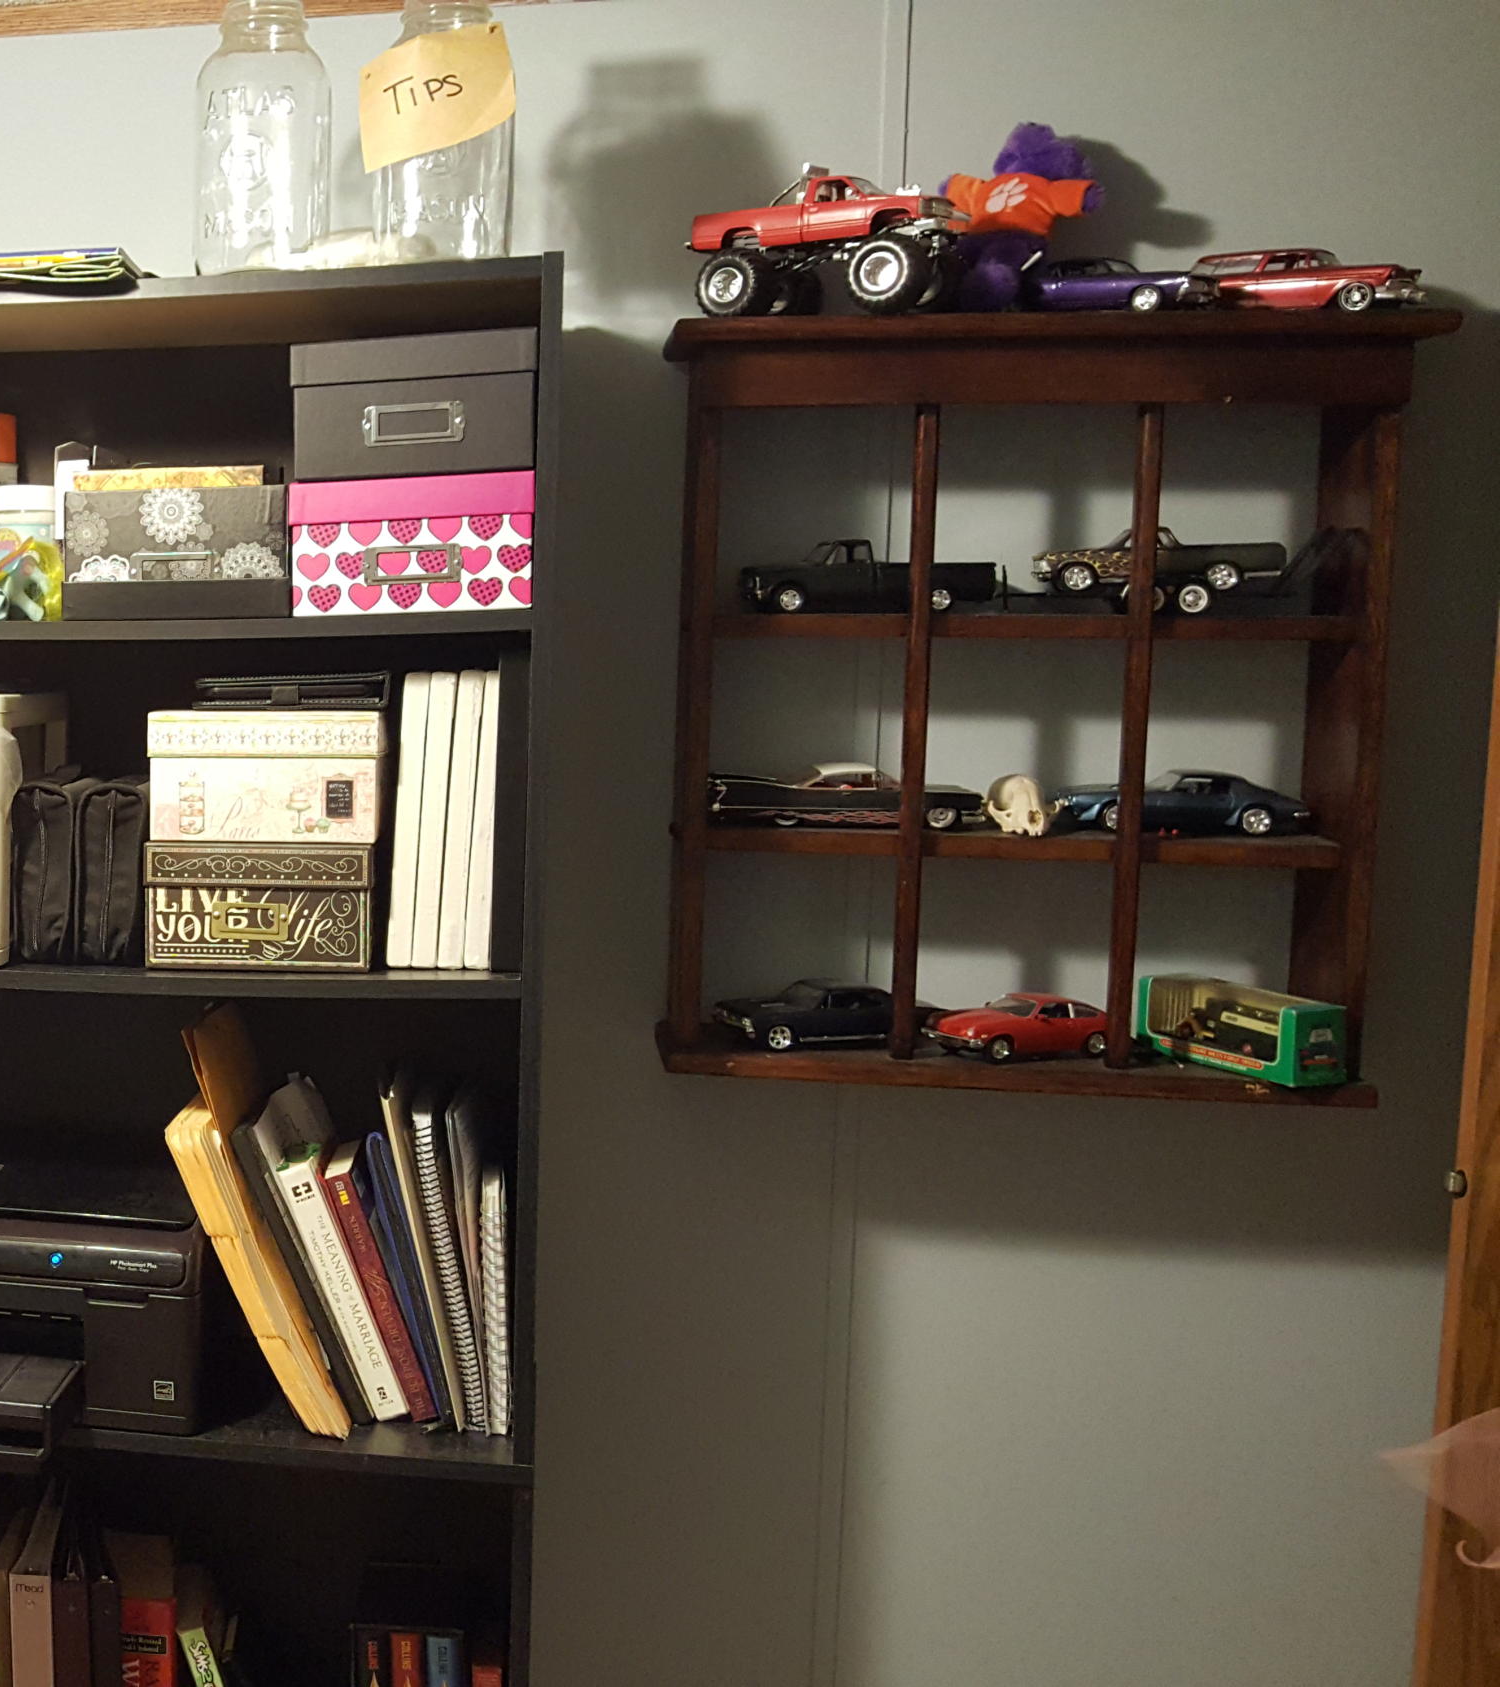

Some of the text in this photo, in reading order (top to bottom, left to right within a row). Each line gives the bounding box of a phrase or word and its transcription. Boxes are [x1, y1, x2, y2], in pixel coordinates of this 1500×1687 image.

[384, 74, 463, 115] TIPS
[155, 887, 250, 914] LIVE
[348, 1215, 368, 1252] WARREN
[321, 1232, 353, 1294] MEANING
[348, 1303, 384, 1371] MARRIAGE
[323, 1270, 342, 1305] KELLER
[396, 1346, 422, 1394] PURPOSE
